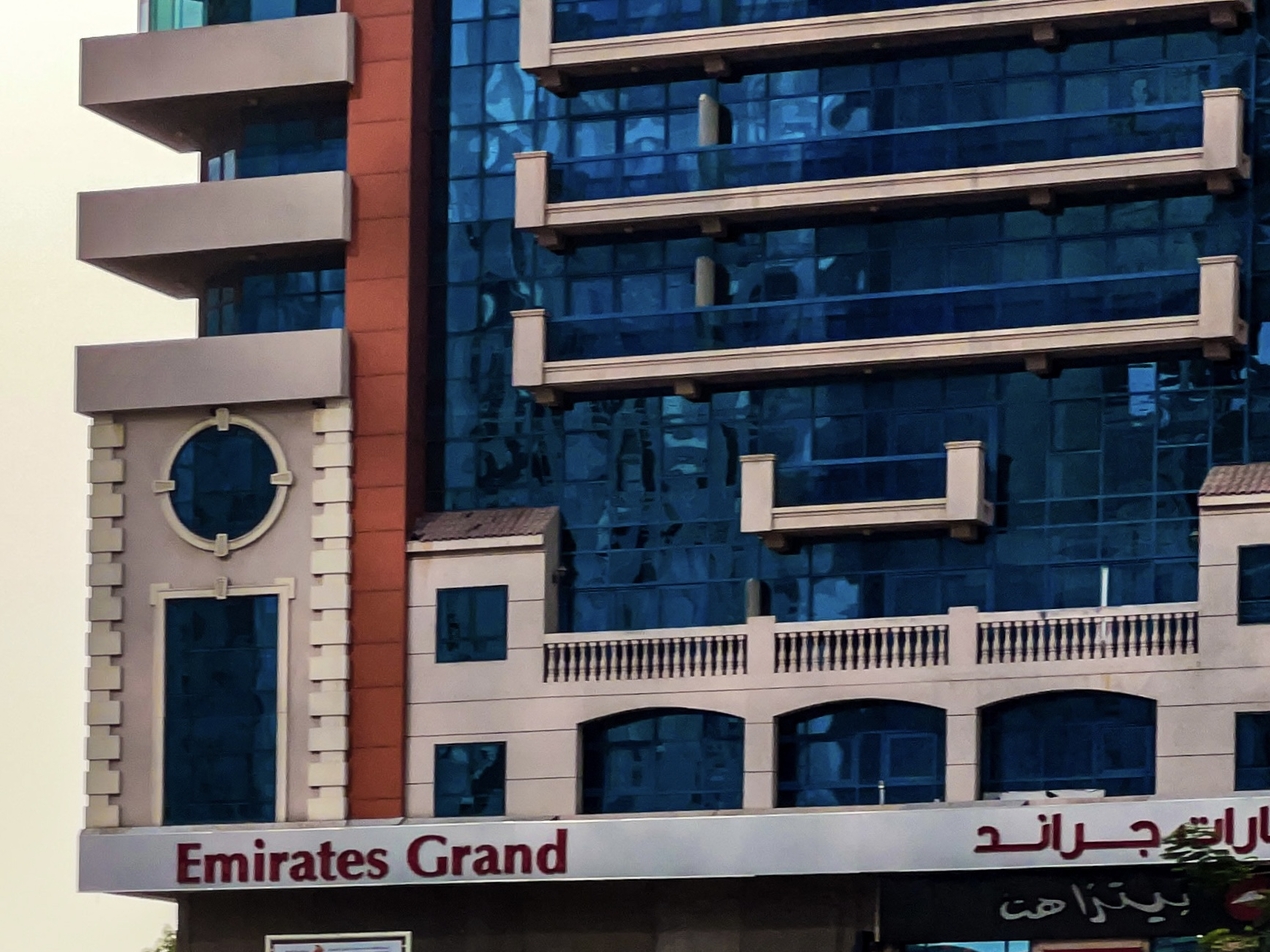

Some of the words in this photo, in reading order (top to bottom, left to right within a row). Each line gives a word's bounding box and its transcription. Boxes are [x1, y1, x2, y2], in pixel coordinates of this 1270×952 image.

[176, 838, 389, 884] Emirates
[407, 828, 569, 878] Grand
[973, 813, 1161, 860] جراند
[999, 897, 1067, 921] هت
